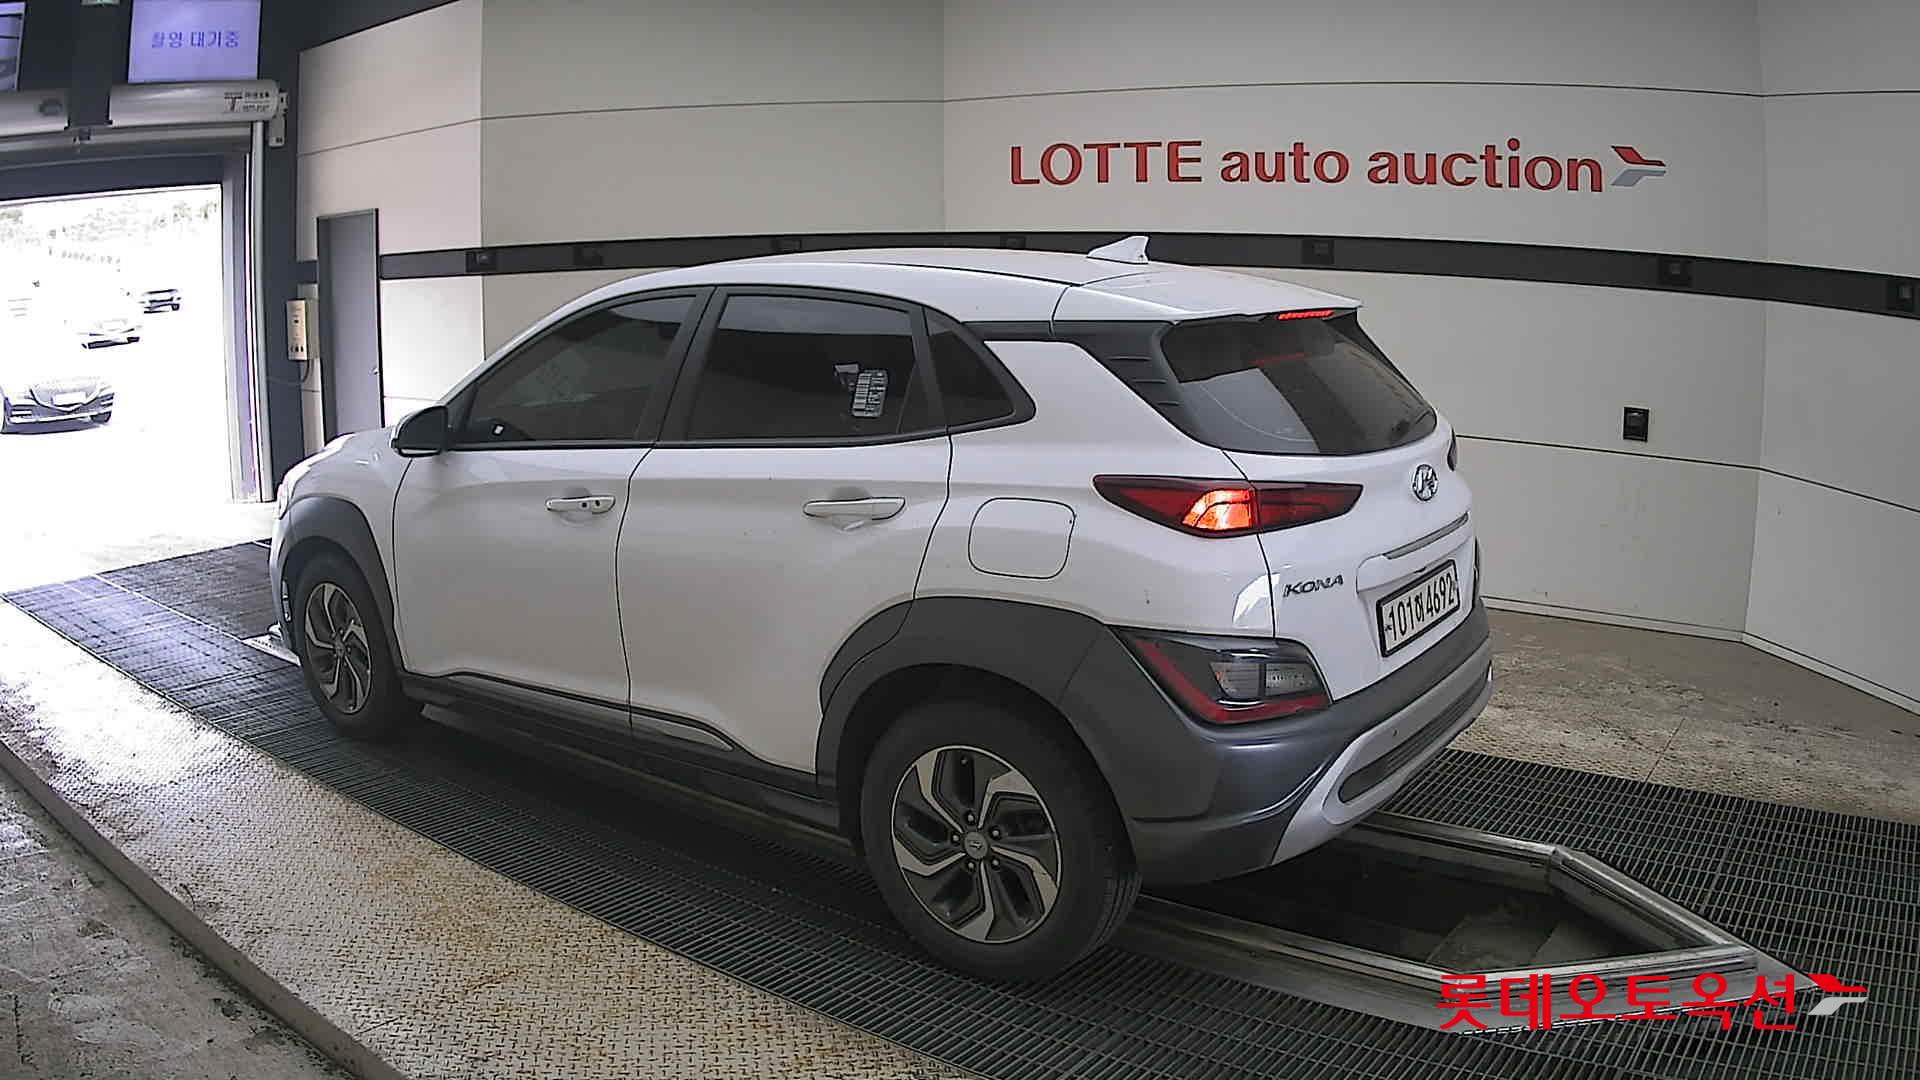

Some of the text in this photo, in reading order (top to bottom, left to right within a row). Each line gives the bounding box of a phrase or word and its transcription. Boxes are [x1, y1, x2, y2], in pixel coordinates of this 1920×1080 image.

[190, 31, 240, 49] 대기중
[1011, 138, 1603, 192] LOTTE auto auction
[1283, 574, 1343, 597] KONA
